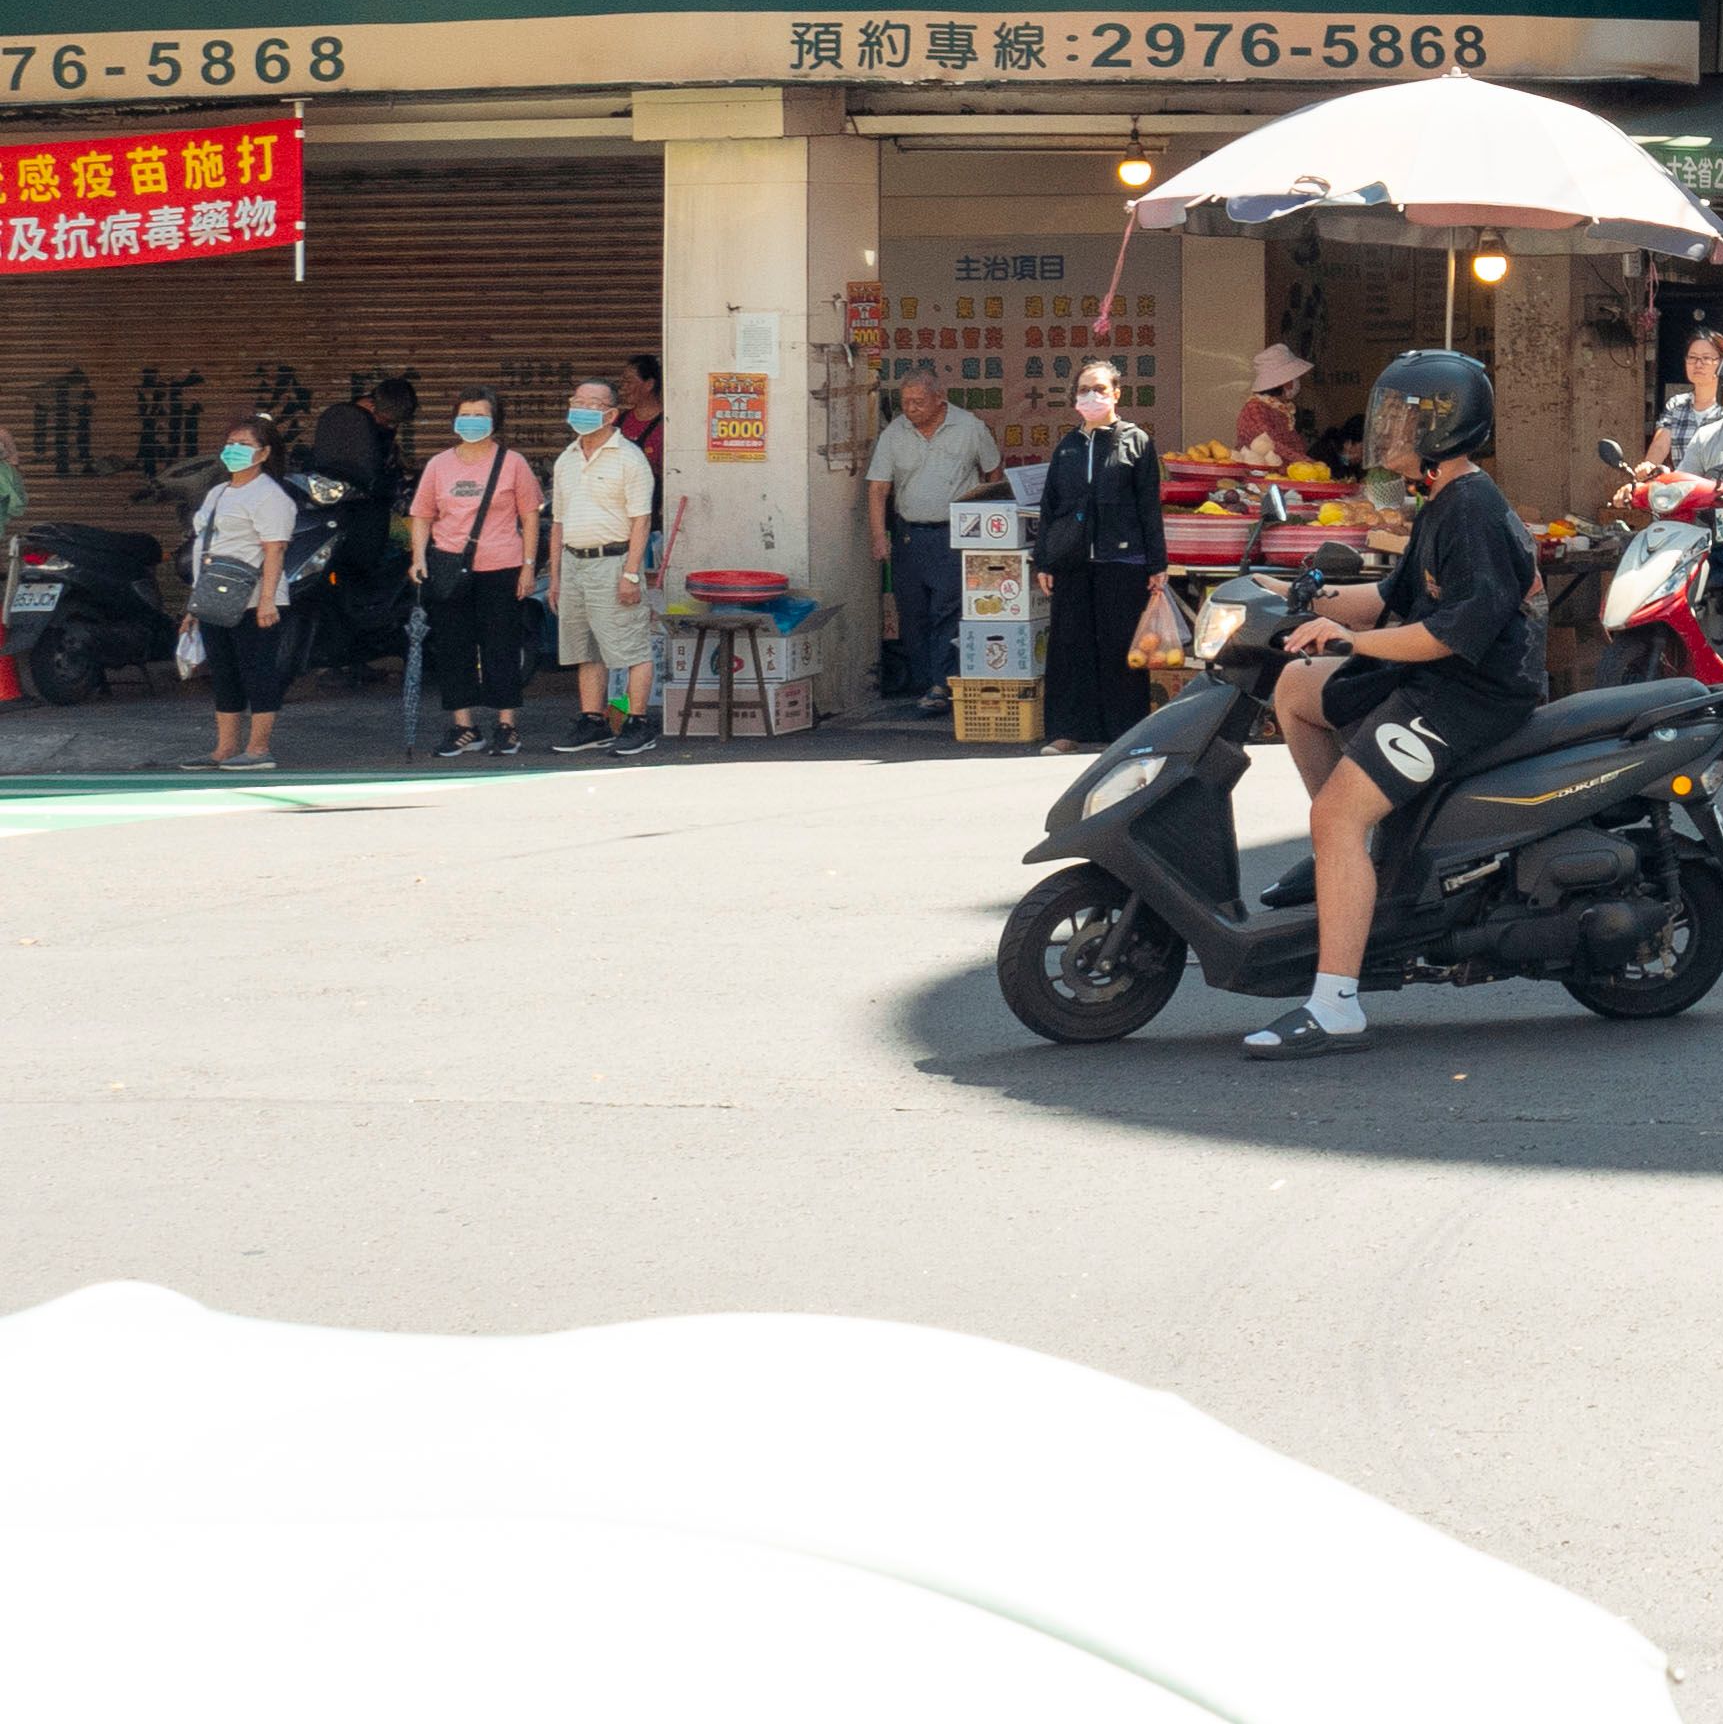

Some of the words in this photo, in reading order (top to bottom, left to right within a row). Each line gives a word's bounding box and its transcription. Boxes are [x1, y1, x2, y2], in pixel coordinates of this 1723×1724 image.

[0, 134, 279, 205] 感疫苗施打
[0, 195, 278, 262] 及抗病毒藥物
[955, 254, 1065, 281] 主治項目
[717, 419, 764, 438] 6000
